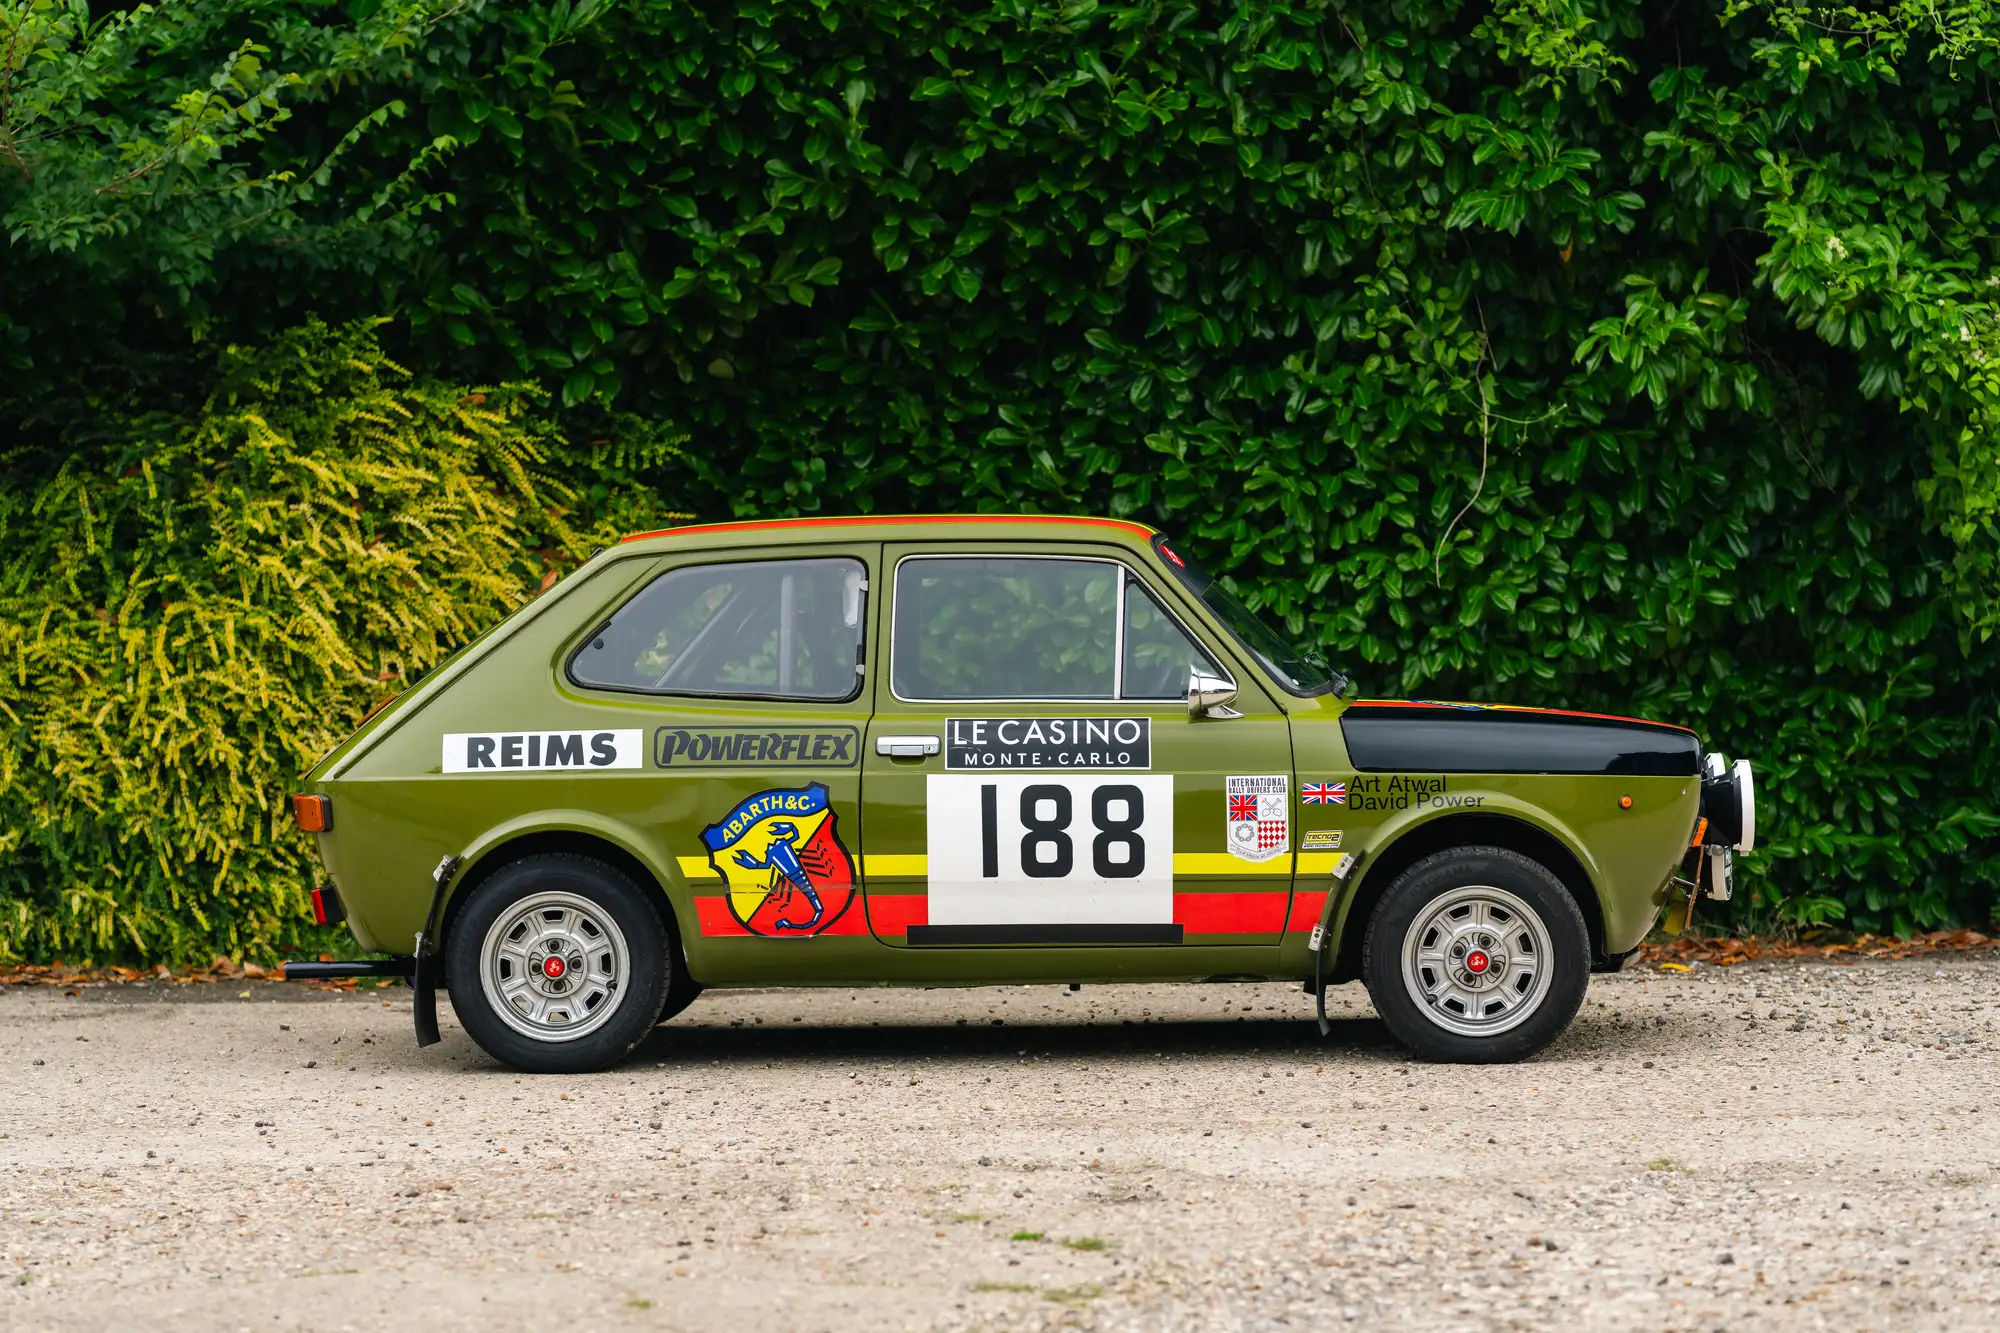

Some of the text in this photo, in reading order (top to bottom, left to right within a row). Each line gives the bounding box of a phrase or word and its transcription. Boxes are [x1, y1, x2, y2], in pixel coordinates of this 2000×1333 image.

[955, 720, 1141, 745] LE CASINO
[467, 733, 617, 768] REIMS
[661, 731, 855, 764] POWERFLEX
[1228, 778, 1286, 787] INTERNATIONAL
[1350, 776, 1446, 792] Art Atwal
[1350, 792, 1485, 809] David Power
[981, 784, 1146, 878] 188
